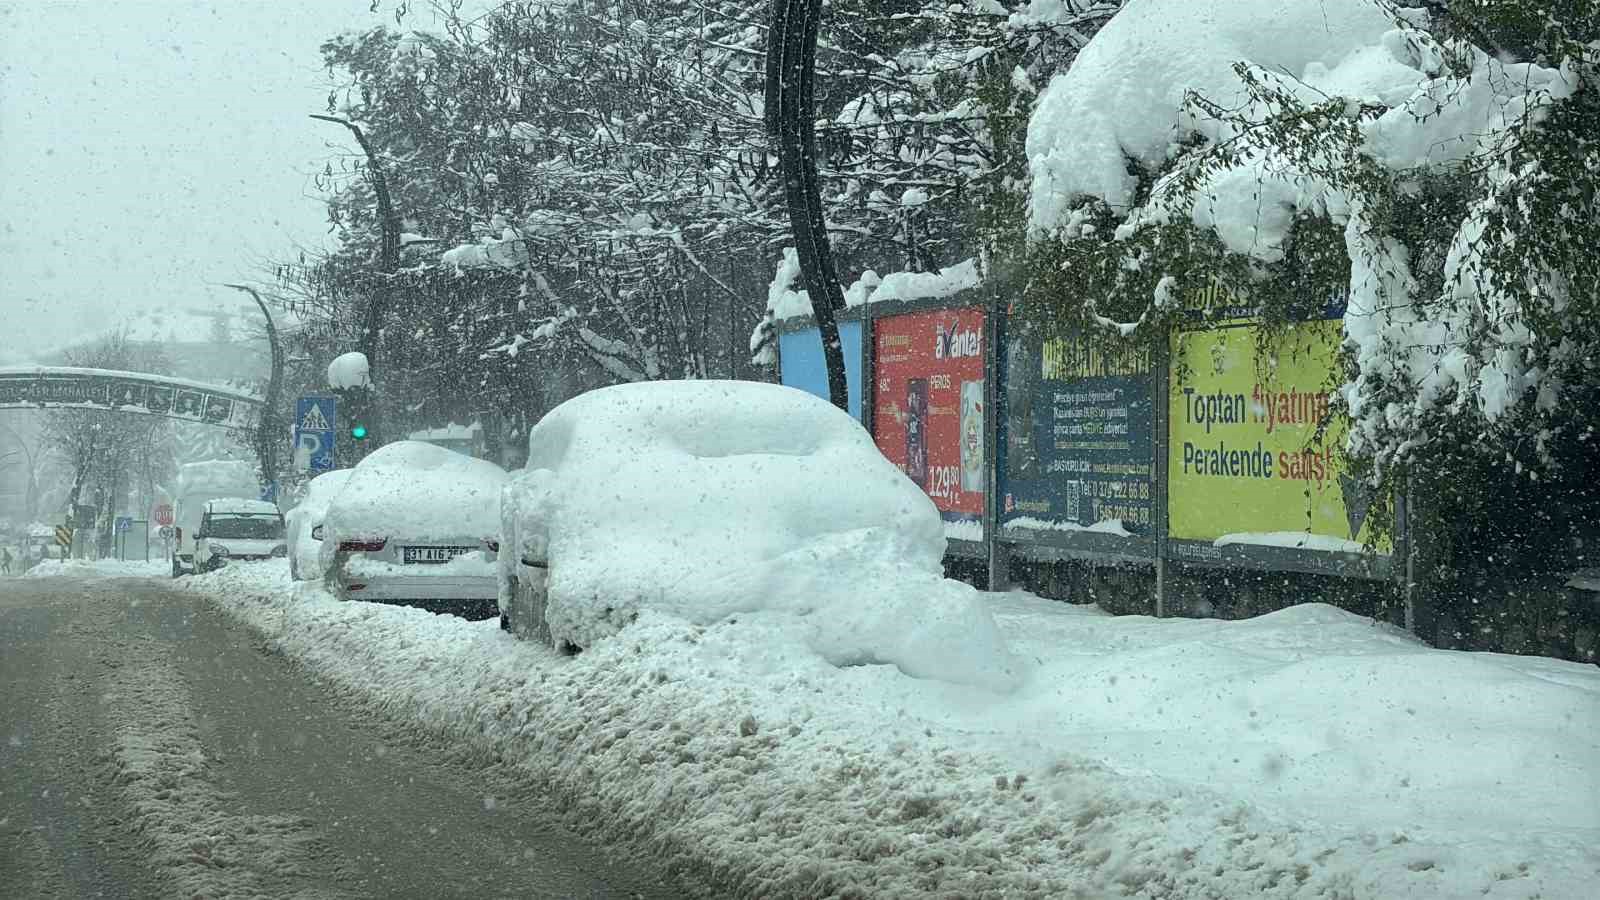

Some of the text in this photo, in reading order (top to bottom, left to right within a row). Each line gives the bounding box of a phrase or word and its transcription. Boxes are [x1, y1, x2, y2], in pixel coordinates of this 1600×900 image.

[1184, 387, 1246, 433] Toptan
[1184, 441, 1272, 478] Perakende
[410, 550, 422, 561] 31
